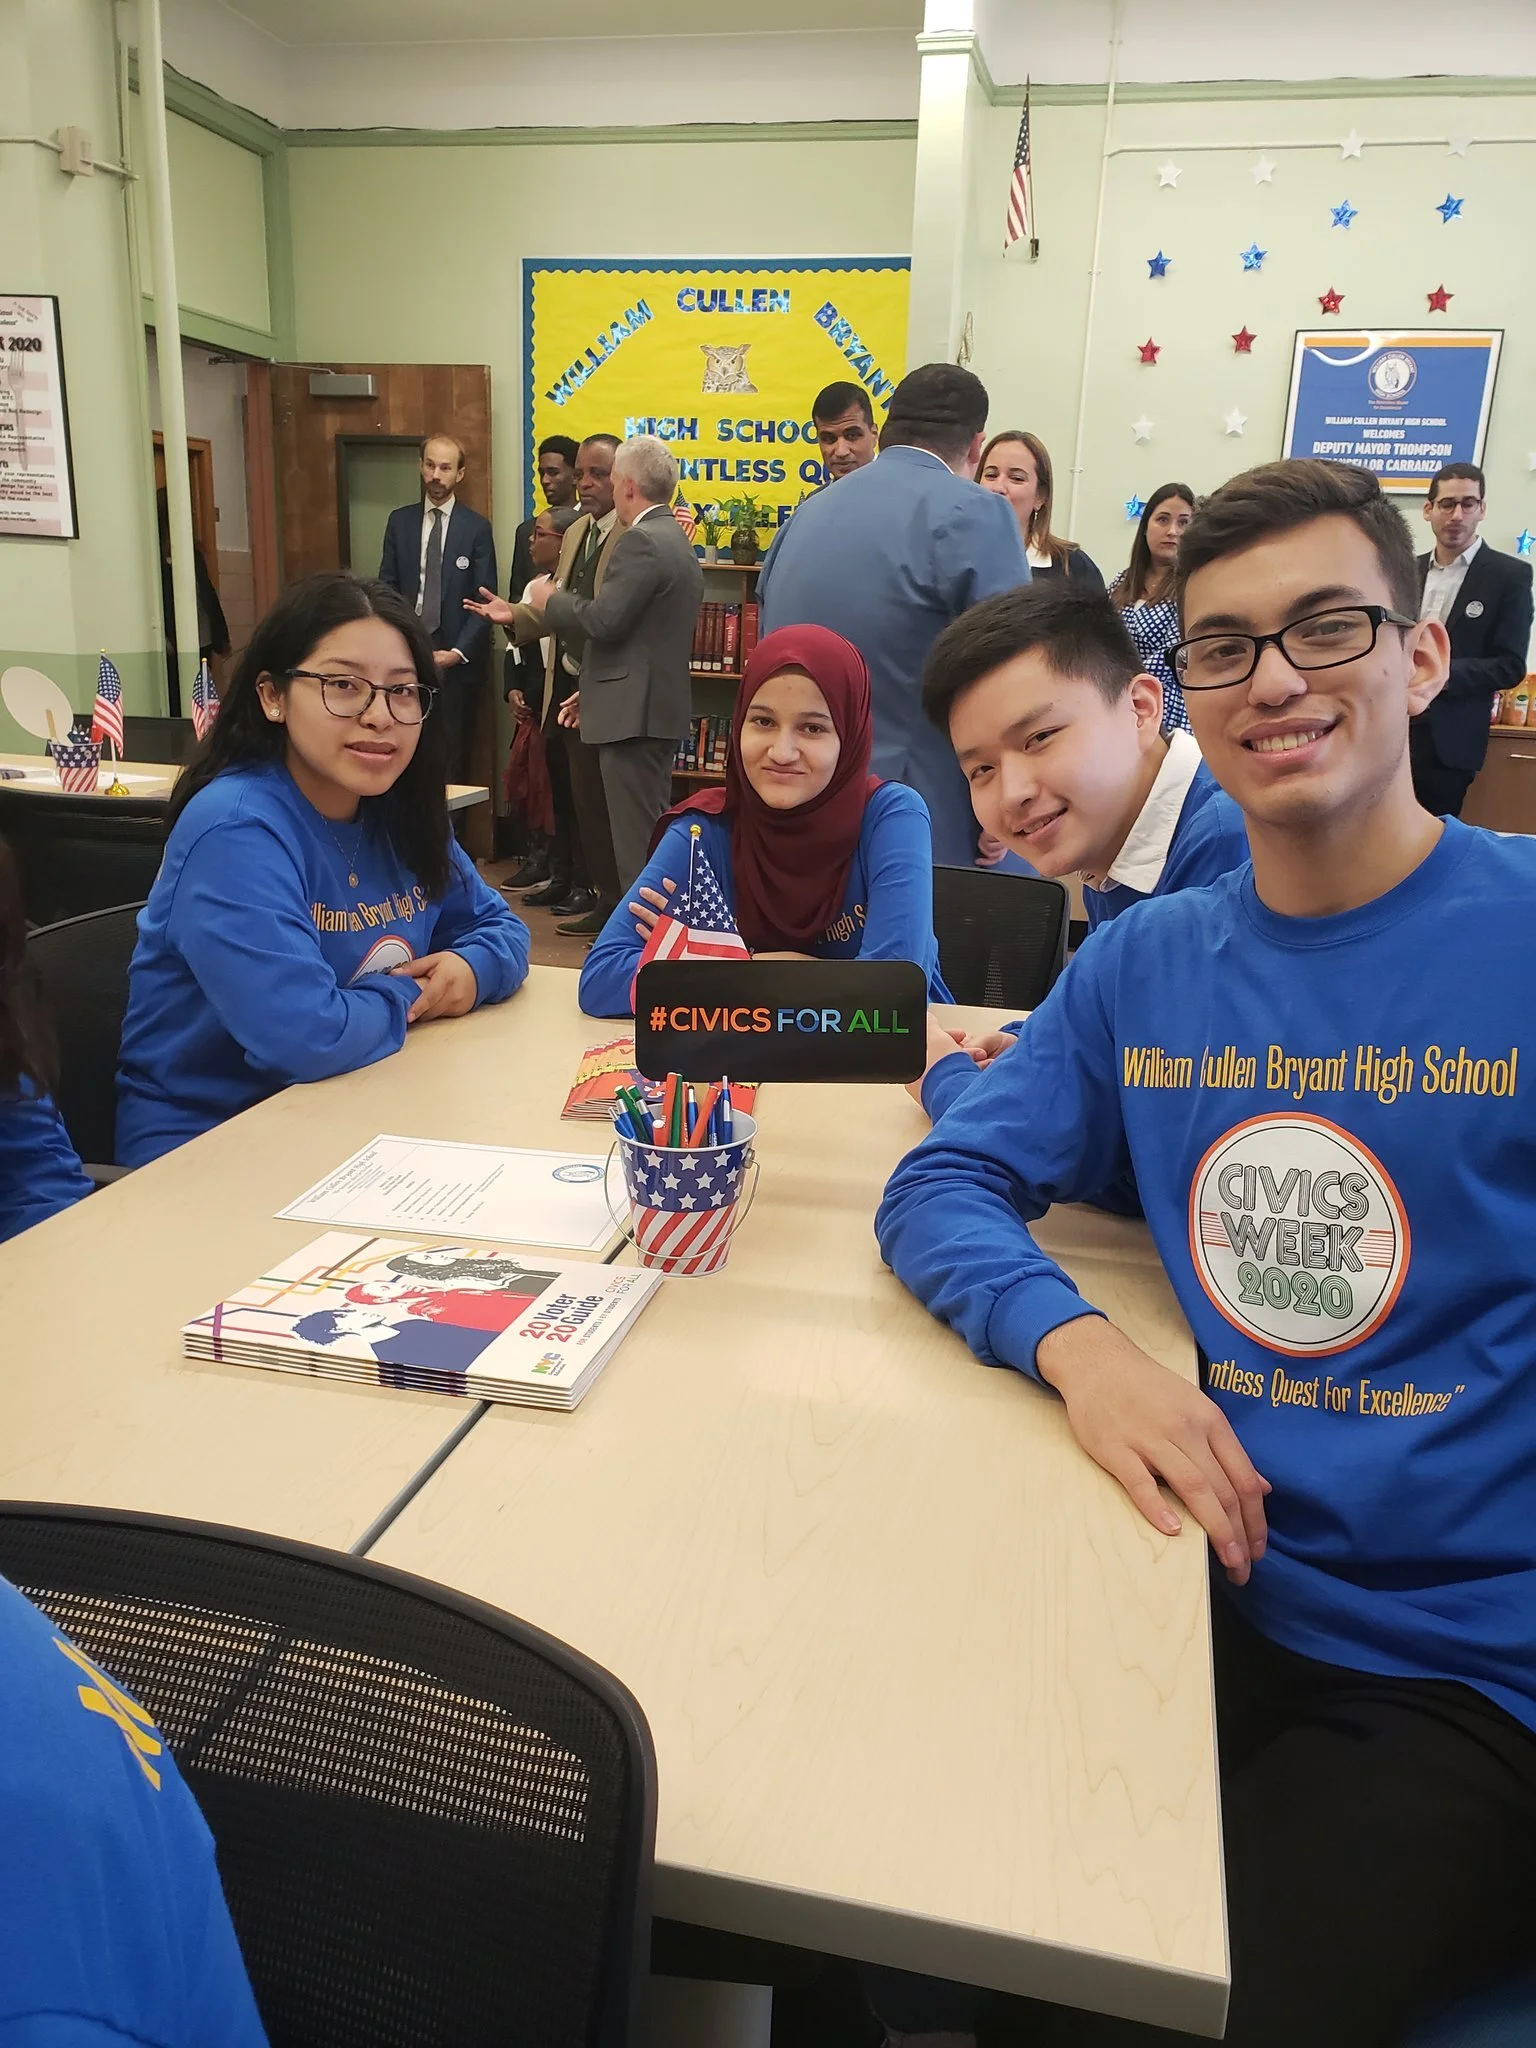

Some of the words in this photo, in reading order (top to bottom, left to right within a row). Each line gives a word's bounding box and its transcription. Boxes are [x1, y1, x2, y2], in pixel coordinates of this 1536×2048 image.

[8, 337, 42, 352] 2020
[545, 299, 654, 407] WILLIAM
[676, 287, 790, 313] CULLEN
[624, 417, 698, 441] HIGH
[717, 418, 818, 444] SCHOO
[1362, 429, 1406, 439] WELCOMES
[1312, 441, 1355, 454] DEPUTY
[1355, 442, 1392, 455] MAYOR
[1394, 443, 1453, 456] THOMPSON
[676, 459, 786, 482] NTLESS
[1386, 459, 1443, 472] CARRANZA
[650, 1006, 772, 1033] #CIVICS
[777, 1008, 842, 1033] FOR
[847, 1009, 910, 1033] ALL
[1123, 1046, 1193, 1088] William
[1266, 1045, 1348, 1099] Bryant
[1354, 1045, 1414, 1104] High
[1422, 1046, 1518, 1097] School
[1217, 1163, 1369, 1221] CIVICS
[1220, 1212, 1364, 1272] WEEK
[1238, 1262, 1354, 1319] 2020
[533, 1294, 577, 1320] Voter
[560, 1296, 604, 1325] Guide
[519, 1321, 551, 1339] 20
[546, 1324, 578, 1342] 20
[1208, 1359, 1264, 1398] ntless
[1270, 1368, 1319, 1408] Quest
[1324, 1376, 1351, 1412] For
